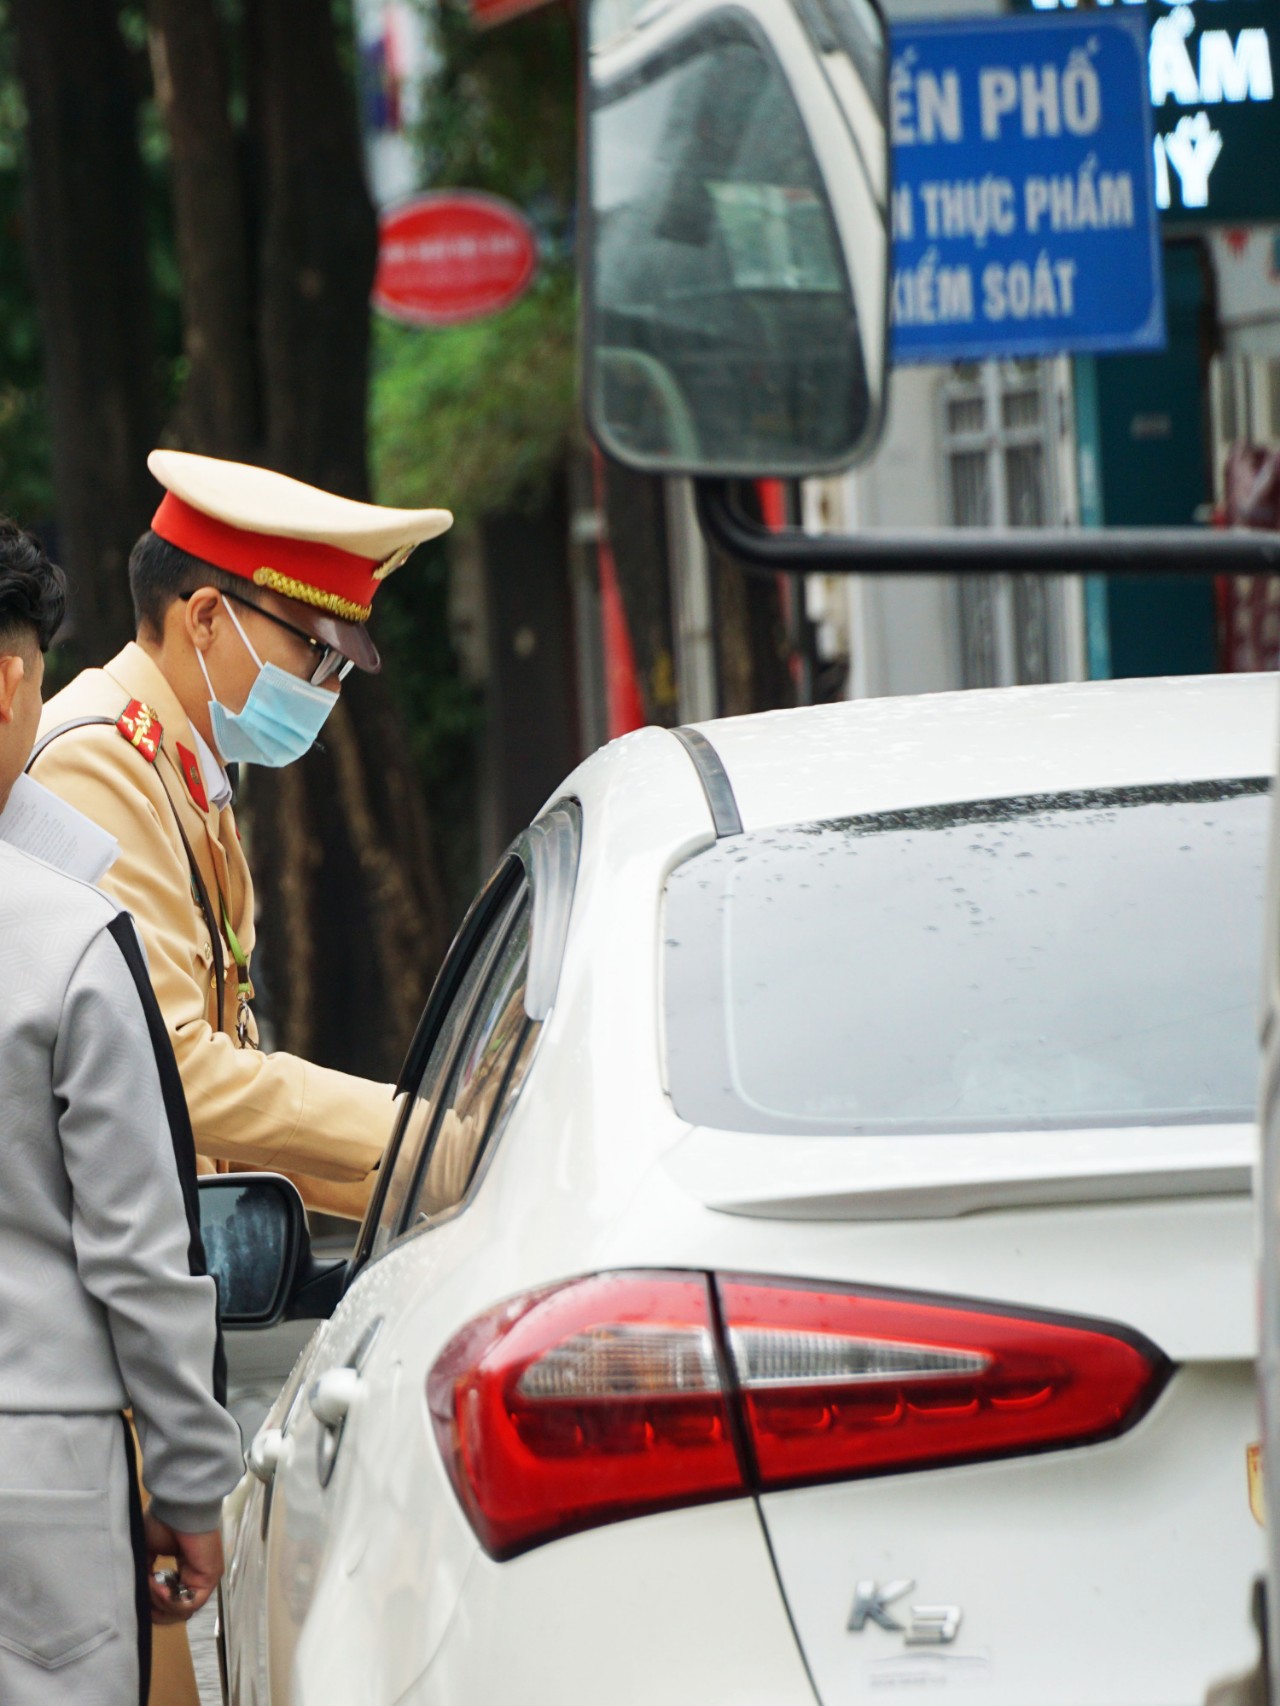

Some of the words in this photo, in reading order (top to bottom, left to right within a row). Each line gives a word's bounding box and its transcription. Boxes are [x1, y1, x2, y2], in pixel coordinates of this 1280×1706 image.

[1153, 111, 1223, 210] Ỹ
[981, 248, 1077, 322] SOÁT
[847, 1579, 963, 1647] K3
